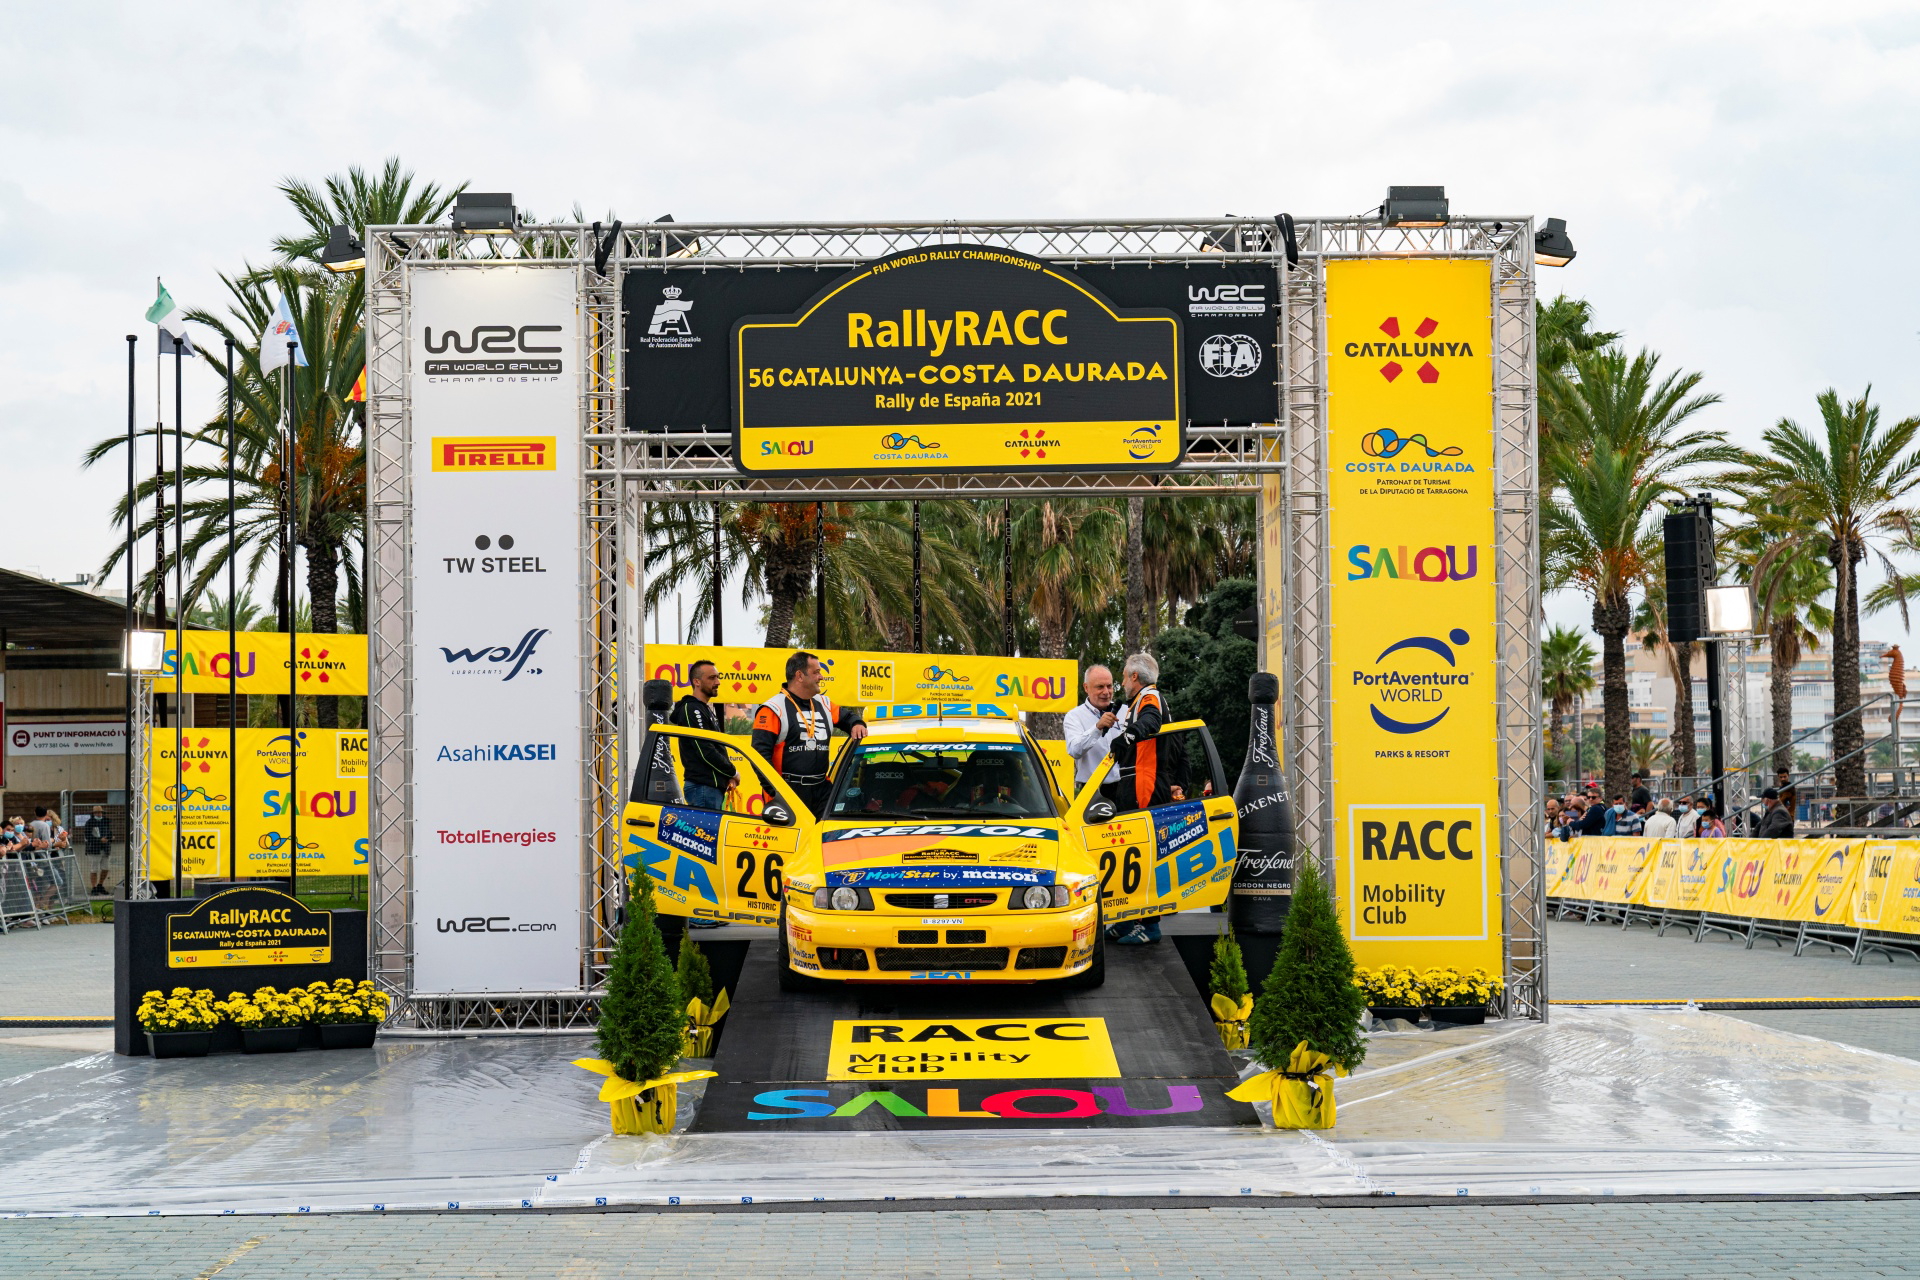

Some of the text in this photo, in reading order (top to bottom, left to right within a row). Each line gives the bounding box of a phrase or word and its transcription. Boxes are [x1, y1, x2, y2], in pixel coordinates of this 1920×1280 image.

[873, 250, 1041, 275] FIA WORLD RALLY CHAMPIONSHIP
[1188, 285, 1265, 301] WRC
[424, 325, 563, 354] WRC
[848, 308, 1068, 357] RallyRACC
[1344, 342, 1474, 357] CATALUNYA
[428, 363, 560, 372] FIA WORLD RALLY
[749, 368, 775, 388] 56
[1023, 361, 1168, 383] DAURADA
[875, 391, 1041, 412] Rally de España 2021
[761, 440, 814, 457] SALOU
[1004, 440, 1061, 448] CATALUNYA
[443, 443, 546, 466] PIRELLI
[904, 452, 949, 460] DAURADA
[1345, 462, 1475, 473] COSTA DAURADA
[280, 480, 289, 555] GALICIA
[156, 475, 164, 595] EXTREMADURA
[713, 503, 721, 573] MELILLA
[817, 508, 825, 576] NAVARRA
[443, 557, 547, 573] TW STEEL
[1347, 544, 1478, 583] SALOU
[861, 665, 891, 679] RACC
[1353, 671, 1469, 686] PortAventura
[861, 684, 884, 693] Mobility
[940, 683, 975, 691] DAURADA
[995, 673, 1066, 700] SALOU
[1380, 688, 1443, 702] WORLD
[875, 703, 1009, 719] IBIZA
[56, 728, 116, 738] D'INFORMACIÓ
[1252, 706, 1274, 768] Freixenet
[160, 750, 229, 759] CAALUNYA
[788, 745, 803, 753] SEAT
[902, 743, 977, 751] REPSOL
[1375, 750, 1451, 758] PARKS & RESORT
[341, 759, 368, 768] Mobility
[674, 818, 716, 843] MoviStar
[1169, 810, 1203, 835] MoviStar
[437, 828, 556, 846] TotalEnergies
[744, 832, 779, 842] CATALUNYA
[837, 824, 1047, 841] REPSOL
[1101, 829, 1132, 839] CATALUNYA
[1159, 824, 1204, 855] by maxon
[1362, 820, 1474, 861] RACC
[661, 830, 712, 857] by maxon
[1232, 848, 1295, 877] Freixenet
[736, 851, 784, 902] 26
[865, 870, 1039, 882] MoviStar by maxon
[1100, 846, 1141, 898] 26
[1717, 857, 1765, 898] SALOU
[1103, 897, 1129, 908] HISTORIC
[1363, 884, 1446, 908] Mobility
[747, 900, 777, 911] HISTORIC
[209, 908, 291, 927] RallyRACC
[1363, 906, 1407, 925] Club
[172, 931, 183, 940] 56
[274, 928, 327, 938] DAURADA
[219, 940, 235, 948] Rally
[245, 939, 267, 948] España
[175, 956, 197, 964] SALOU
[910, 970, 976, 979] SEAT
[850, 1023, 1090, 1043] RACC
[848, 1050, 1031, 1064] Mobility
[846, 1063, 944, 1074] Club
[747, 1085, 1205, 1120] SALOU
